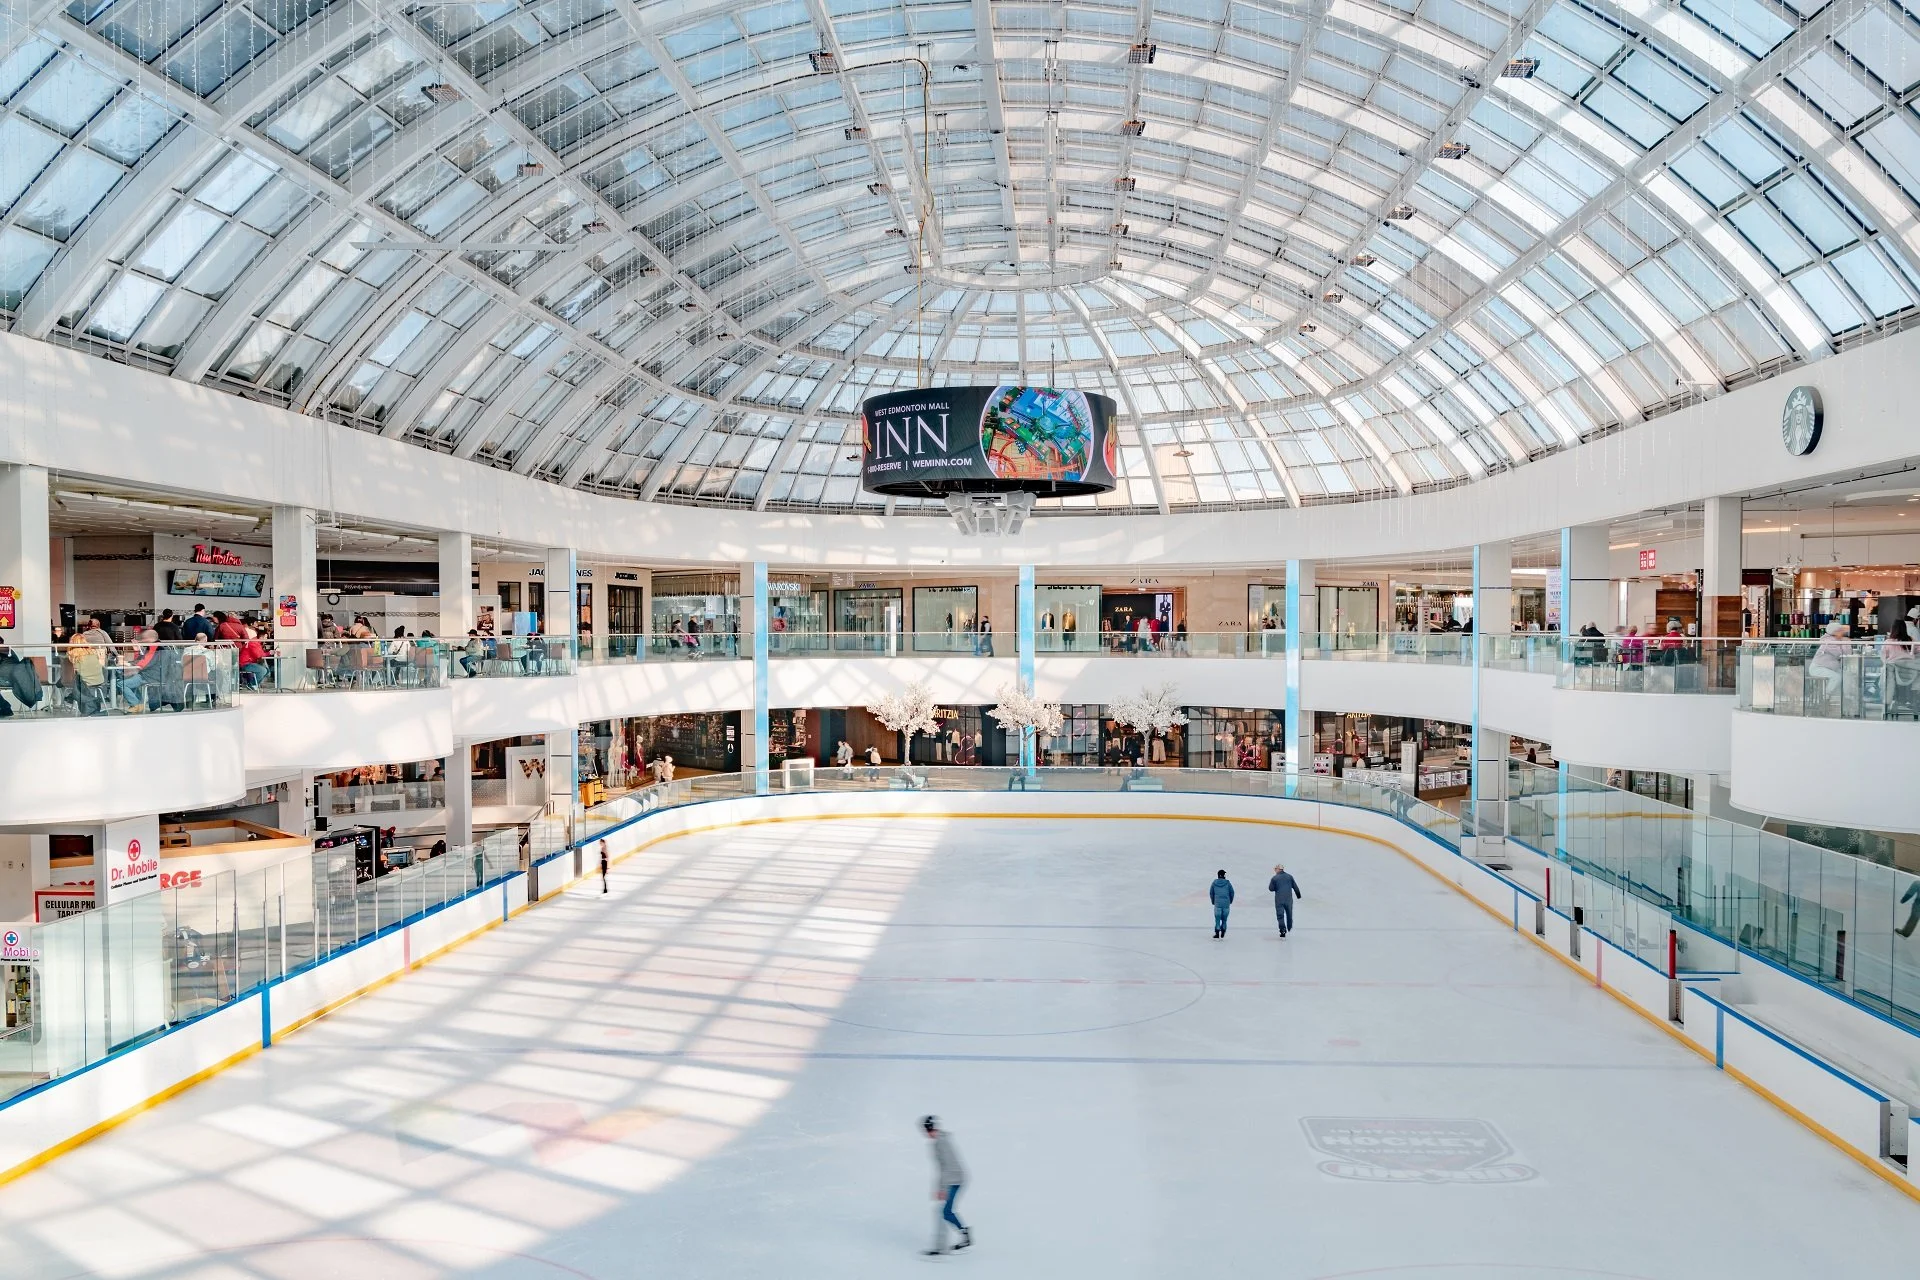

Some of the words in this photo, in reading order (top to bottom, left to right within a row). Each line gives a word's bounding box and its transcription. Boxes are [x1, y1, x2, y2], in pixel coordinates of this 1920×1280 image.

[875, 408, 887, 416] WEST
[888, 404, 926, 414] EDMONTON
[928, 402, 949, 410] MALL
[875, 414, 949, 459] INN
[913, 458, 972, 467] WEMINN.COM
[192, 545, 211, 563] Tim
[768, 583, 800, 591] WAROVSKI
[518, 758, 546, 779] W
[111, 867, 125, 881] Dr.
[127, 859, 158, 877] Mobile
[160, 870, 202, 889] RGE
[45, 900, 80, 909] CELLULAR
[81, 900, 96, 909] PHO
[4, 947, 39, 957] Mobie
[1321, 1136, 1488, 1147] HOCKEY
